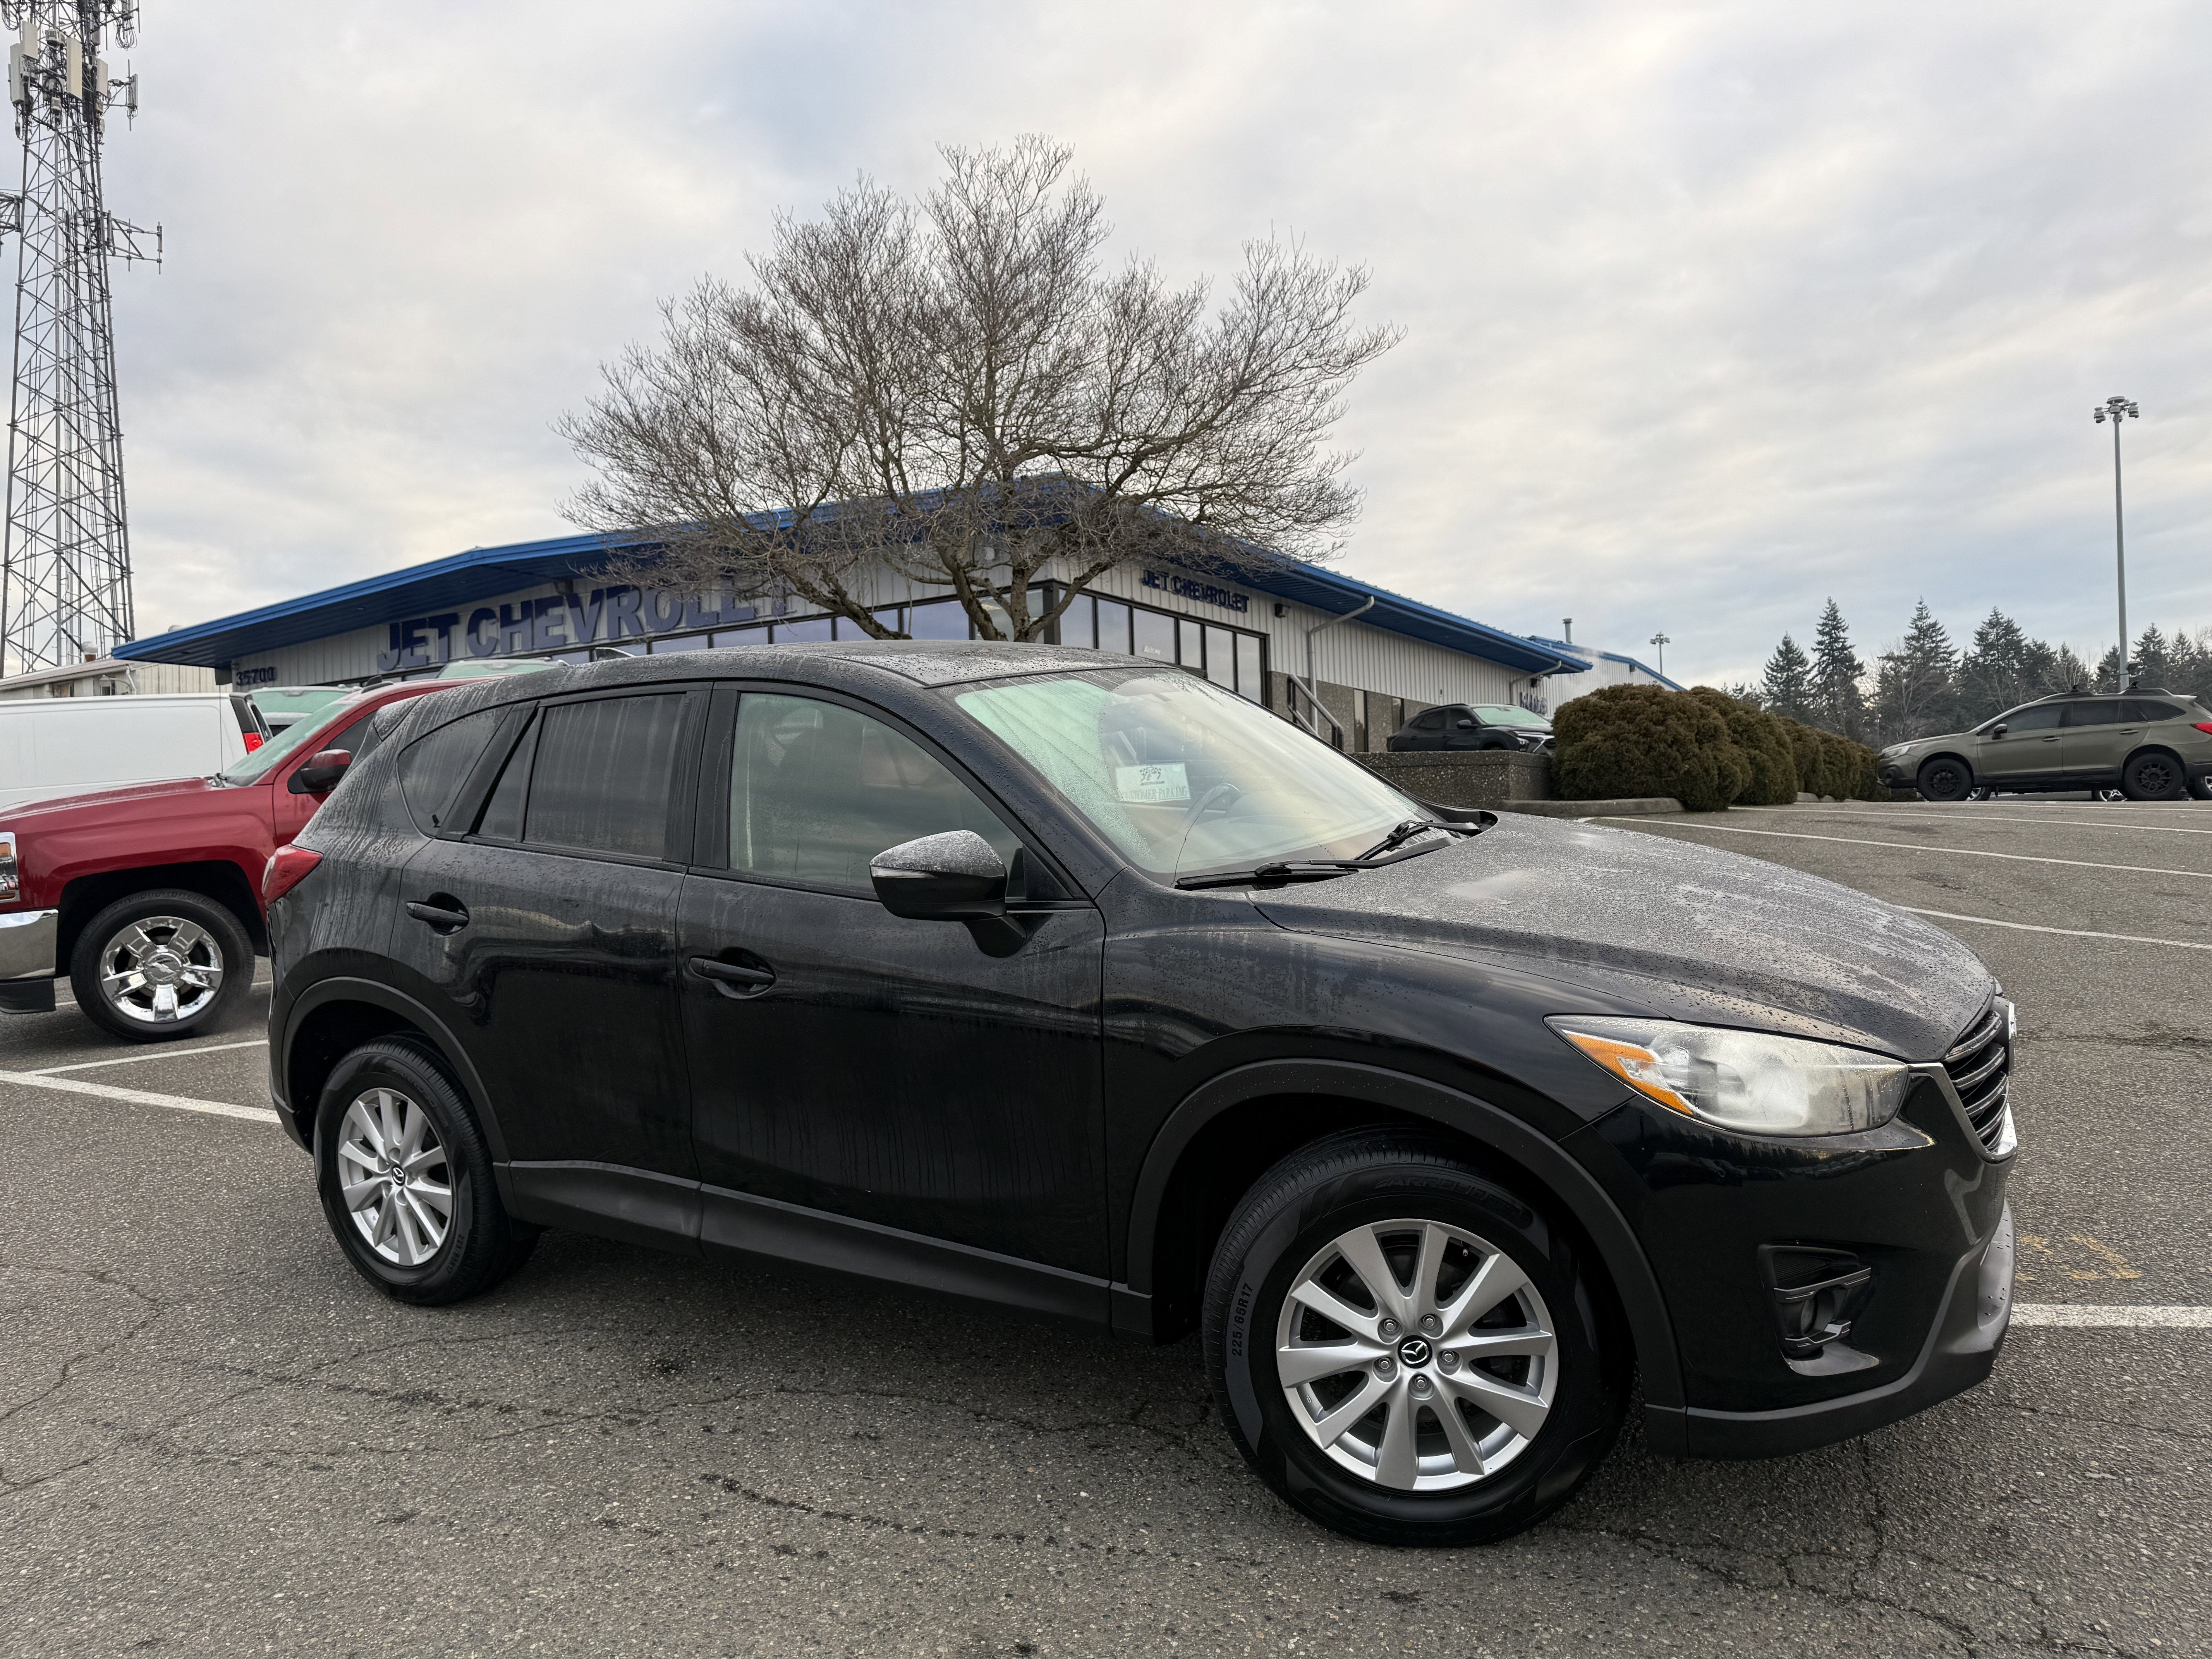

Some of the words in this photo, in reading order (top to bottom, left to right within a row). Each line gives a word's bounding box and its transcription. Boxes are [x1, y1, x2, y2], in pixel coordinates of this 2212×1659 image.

[1141, 570, 1169, 591] JET
[1171, 576, 1249, 613] CHEVROLET
[377, 612, 459, 671] JET
[236, 666, 276, 686] 35700
[1159, 786, 1187, 799] PARKING
[1232, 1282, 1253, 1357] 225/65R17
